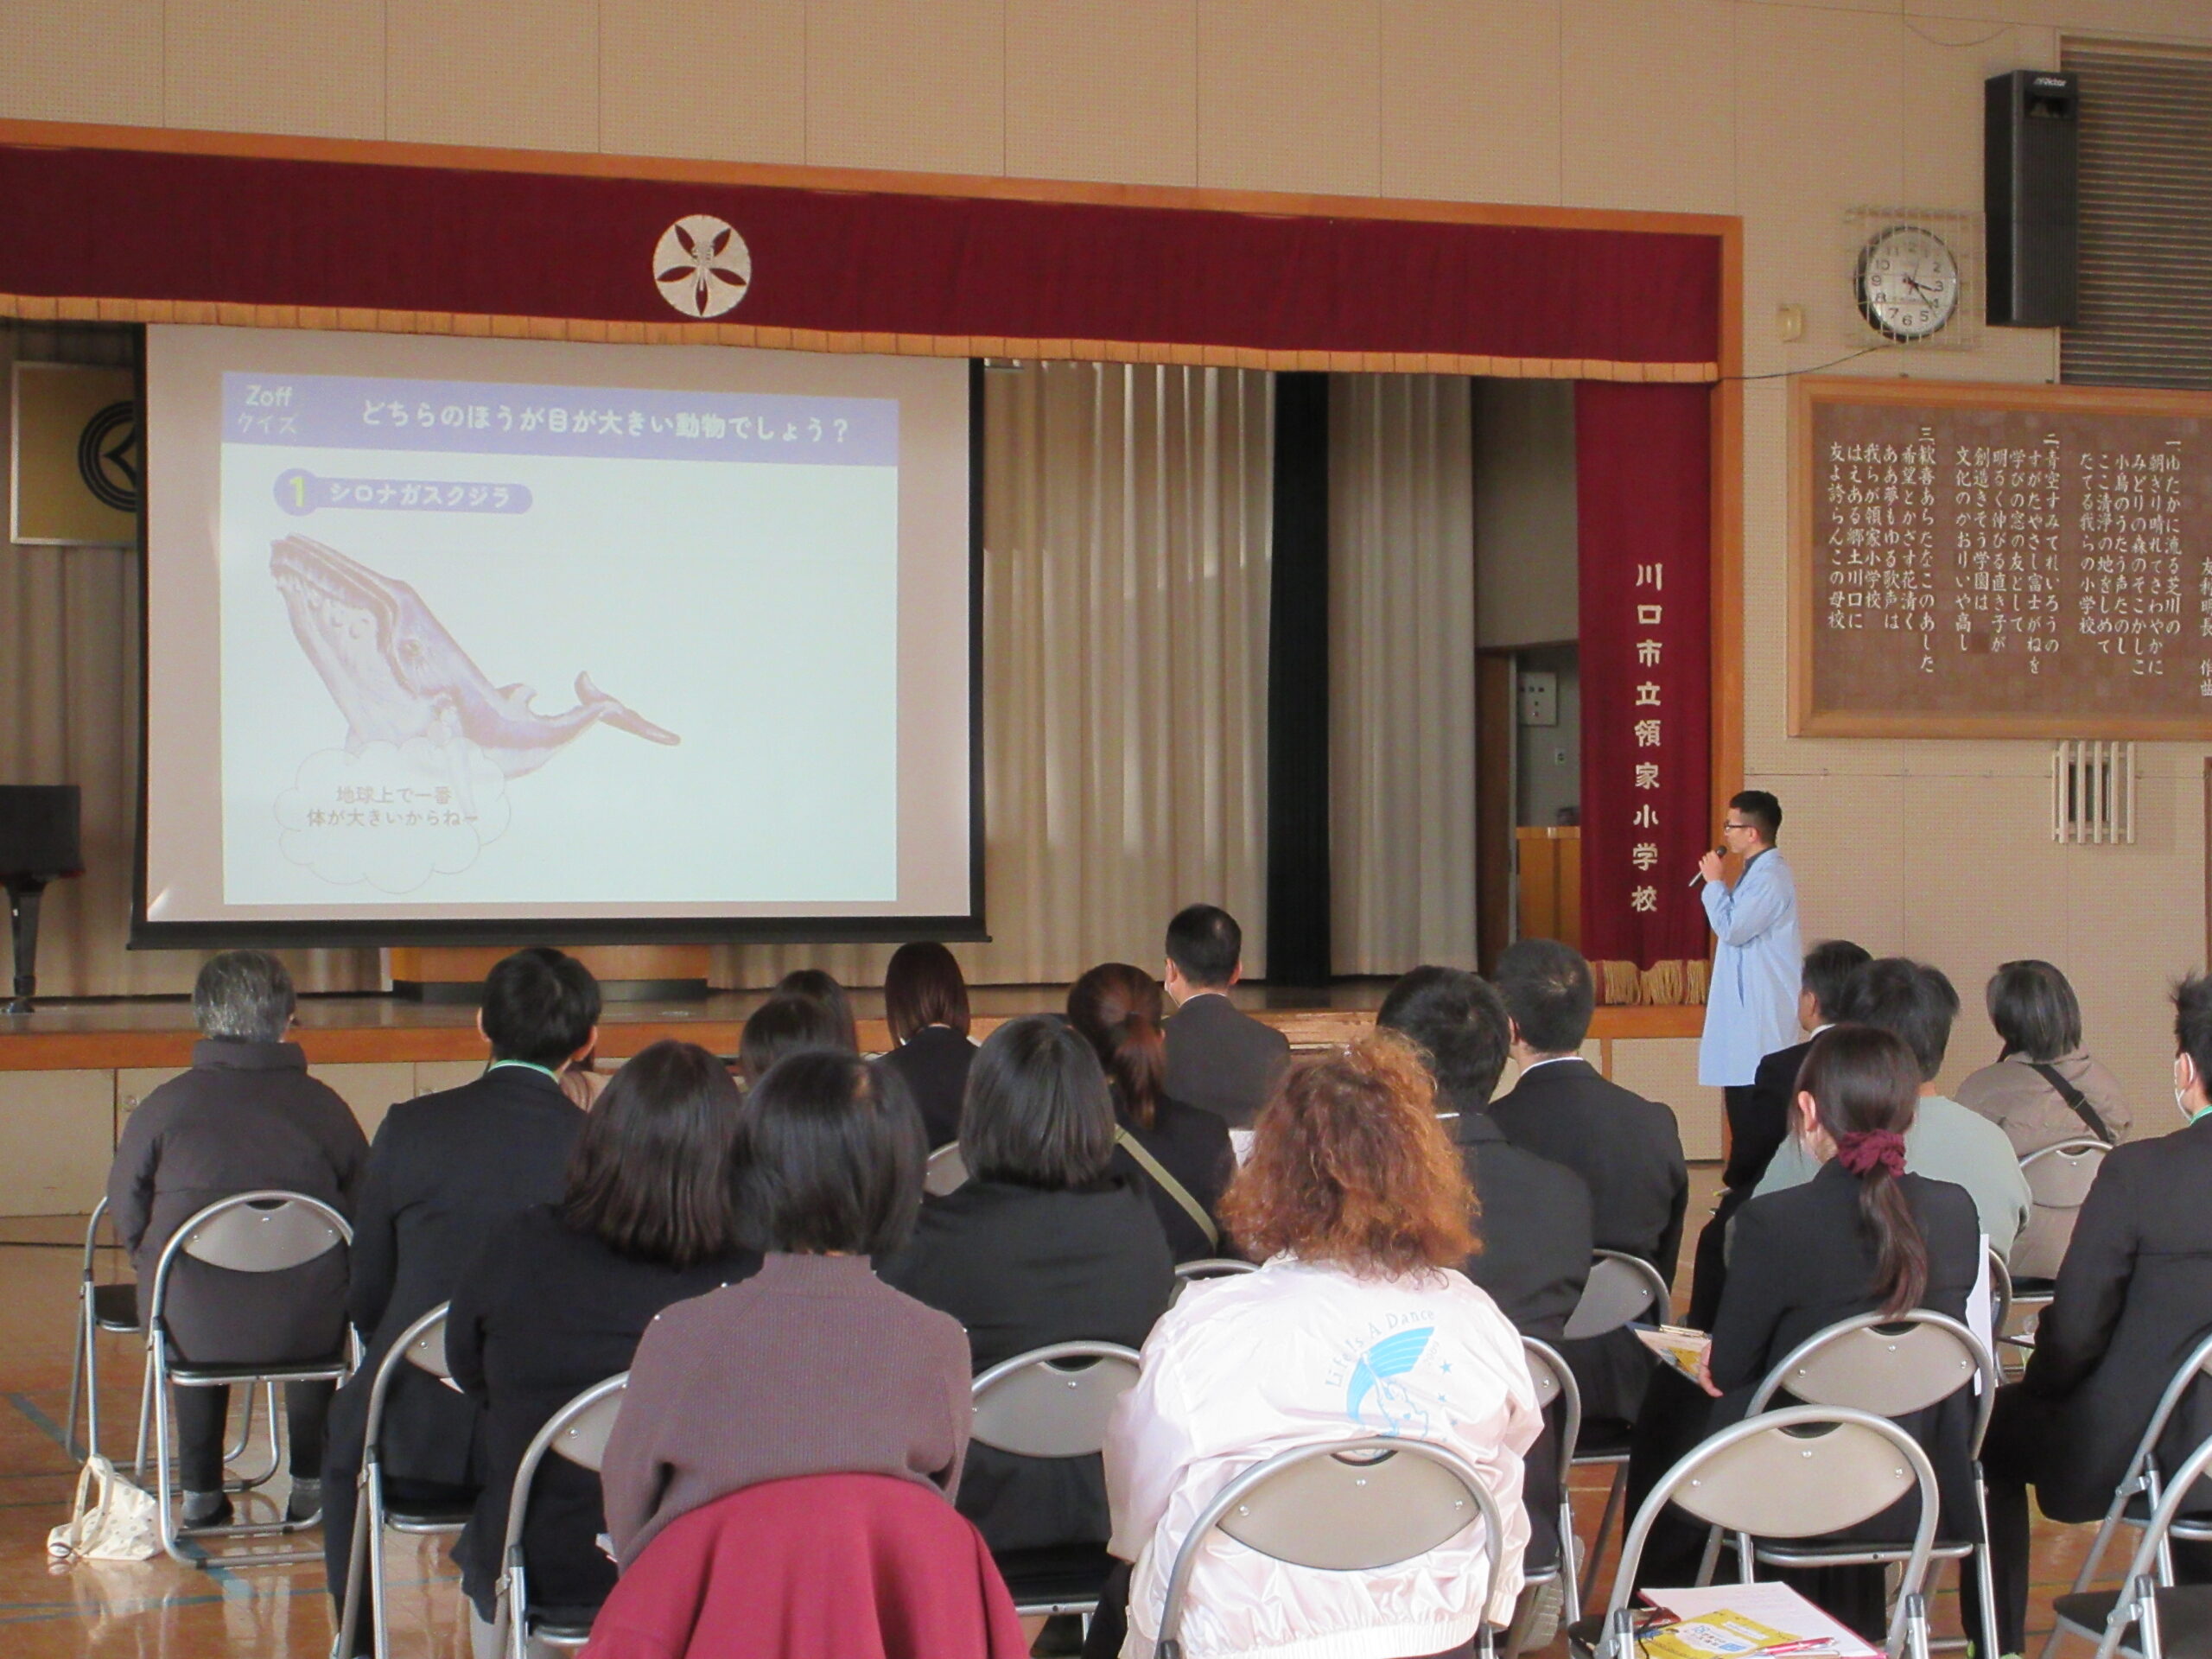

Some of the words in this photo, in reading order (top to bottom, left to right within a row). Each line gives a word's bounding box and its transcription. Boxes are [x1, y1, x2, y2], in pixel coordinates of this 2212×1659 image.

[1871, 275, 1882, 287] 9
[1875, 260, 1891, 270] 10
[1889, 307, 1899, 319] 7
[1902, 315, 1913, 327] 6
[1920, 310, 1929, 322] 5
[1935, 280, 1944, 292] 3
[245, 385, 293, 407] Zoff
[362, 399, 849, 442] どちらのほうが目が大きい動物でしょう？
[289, 476, 305, 508] 1
[330, 482, 510, 508] シロナガスクジラ
[1827, 442, 1847, 630] 友よ誇らんこの母校
[1847, 443, 1865, 629] はえある郷土川口に
[1864, 442, 1882, 610] 我らが領家小学校
[1883, 443, 1901, 629] ああ夢もゆる歌声は
[1901, 443, 1918, 631] 希望とかざす花清く
[1955, 446, 1973, 652] 文化のかおりいや高し
[2078, 453, 2097, 635] たてる我らの小学校
[2027, 449, 2044, 675] すがたやさし富士がねを
[2113, 454, 2131, 655] 小鳥のうたう声たのし
[2130, 454, 2148, 676] みどりの森のそこかしこ
[335, 785, 452, 805] 地球上で一番
[1630, 562, 1664, 914] 川口市立領家小学校
[1325, 1351, 1352, 1388] Life
[1368, 1321, 1382, 1339] A
[1385, 1309, 1435, 1329] Dance
